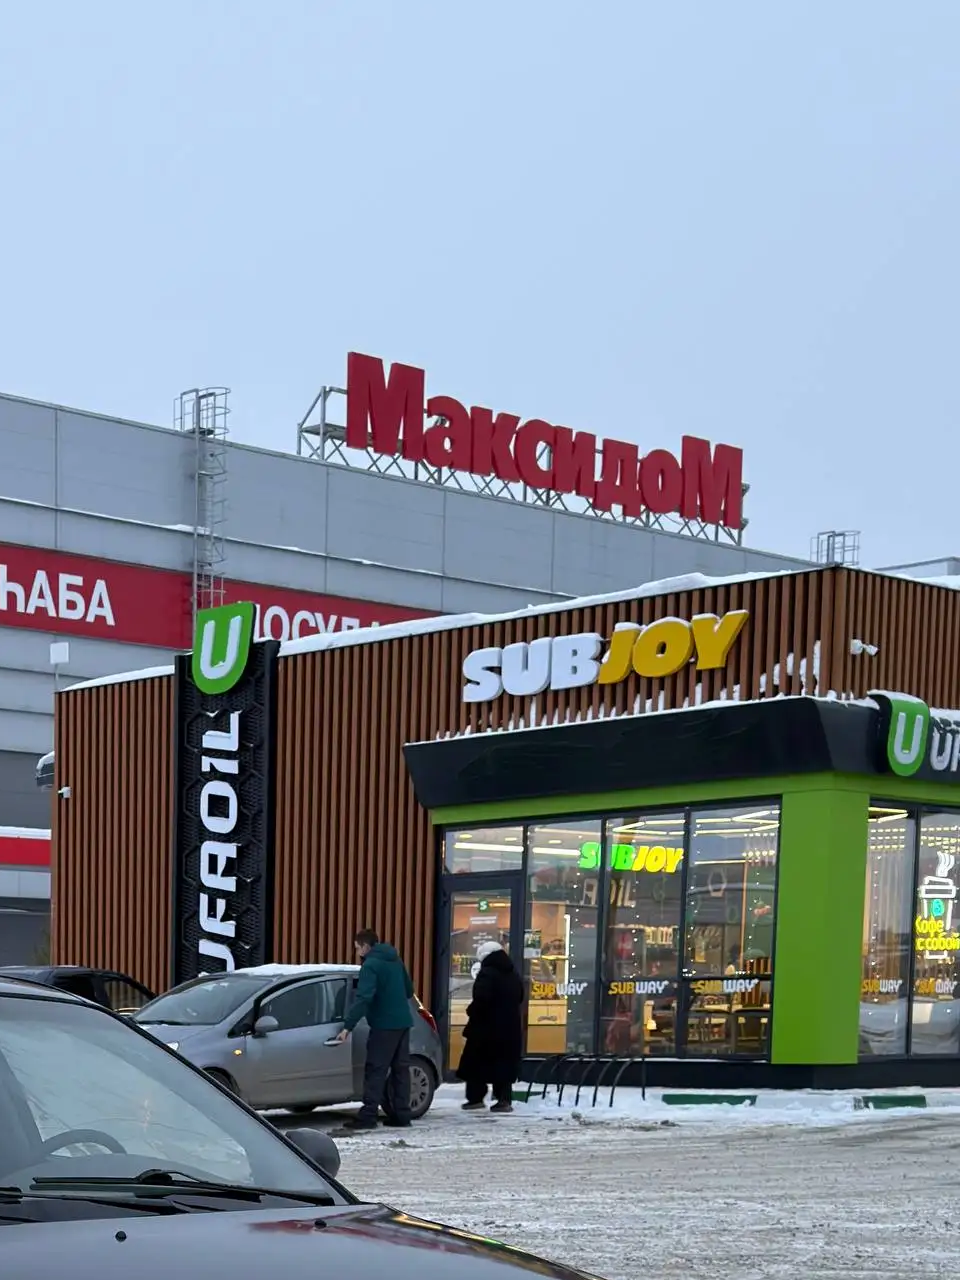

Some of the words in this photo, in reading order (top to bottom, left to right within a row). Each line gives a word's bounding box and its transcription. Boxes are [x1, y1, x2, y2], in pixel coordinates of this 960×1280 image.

[253, 604, 381, 642] ОСУ
[198, 614, 243, 680] U
[462, 609, 749, 702] SUBJOY
[894, 711, 923, 764] U
[197, 711, 240, 978] UFAOIL
[532, 981, 588, 995] SUBWAY
[608, 980, 670, 995] SUBWAY
[695, 978, 759, 993] SUBWAY
[861, 978, 903, 993] SUBWAY
